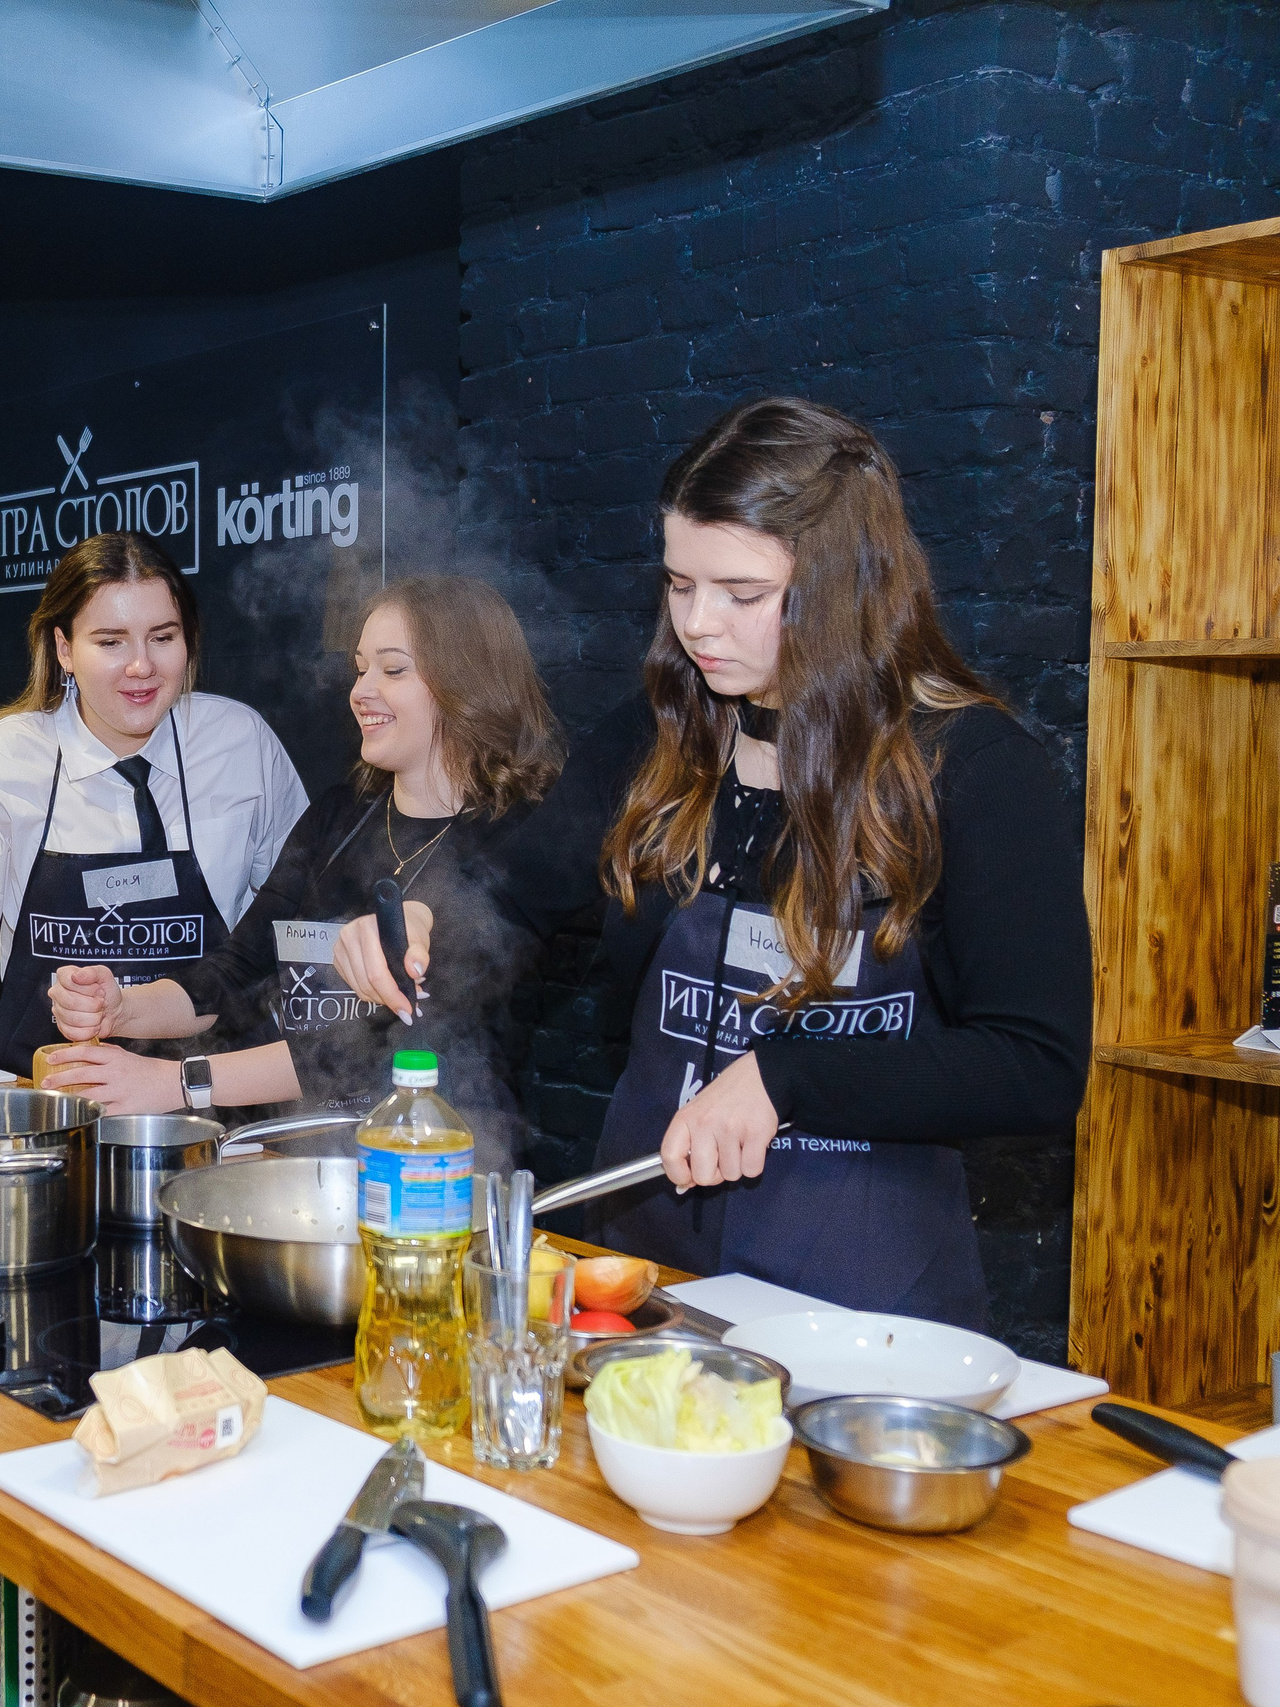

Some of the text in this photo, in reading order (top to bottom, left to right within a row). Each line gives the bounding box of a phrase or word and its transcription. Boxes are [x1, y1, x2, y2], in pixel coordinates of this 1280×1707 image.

[303, 465, 351, 486] since 1889
[217, 475, 359, 548] körting
[5, 558, 61, 580] КУЛИНАР
[105, 874, 141, 890] Соня
[34, 919, 198, 947] ИГРА СТОЛОВ
[749, 926, 785, 954] Нас
[52, 946, 170, 956] КУЛИНАРНАЯ СТУДИЯ
[798, 1137, 871, 1152] техника
